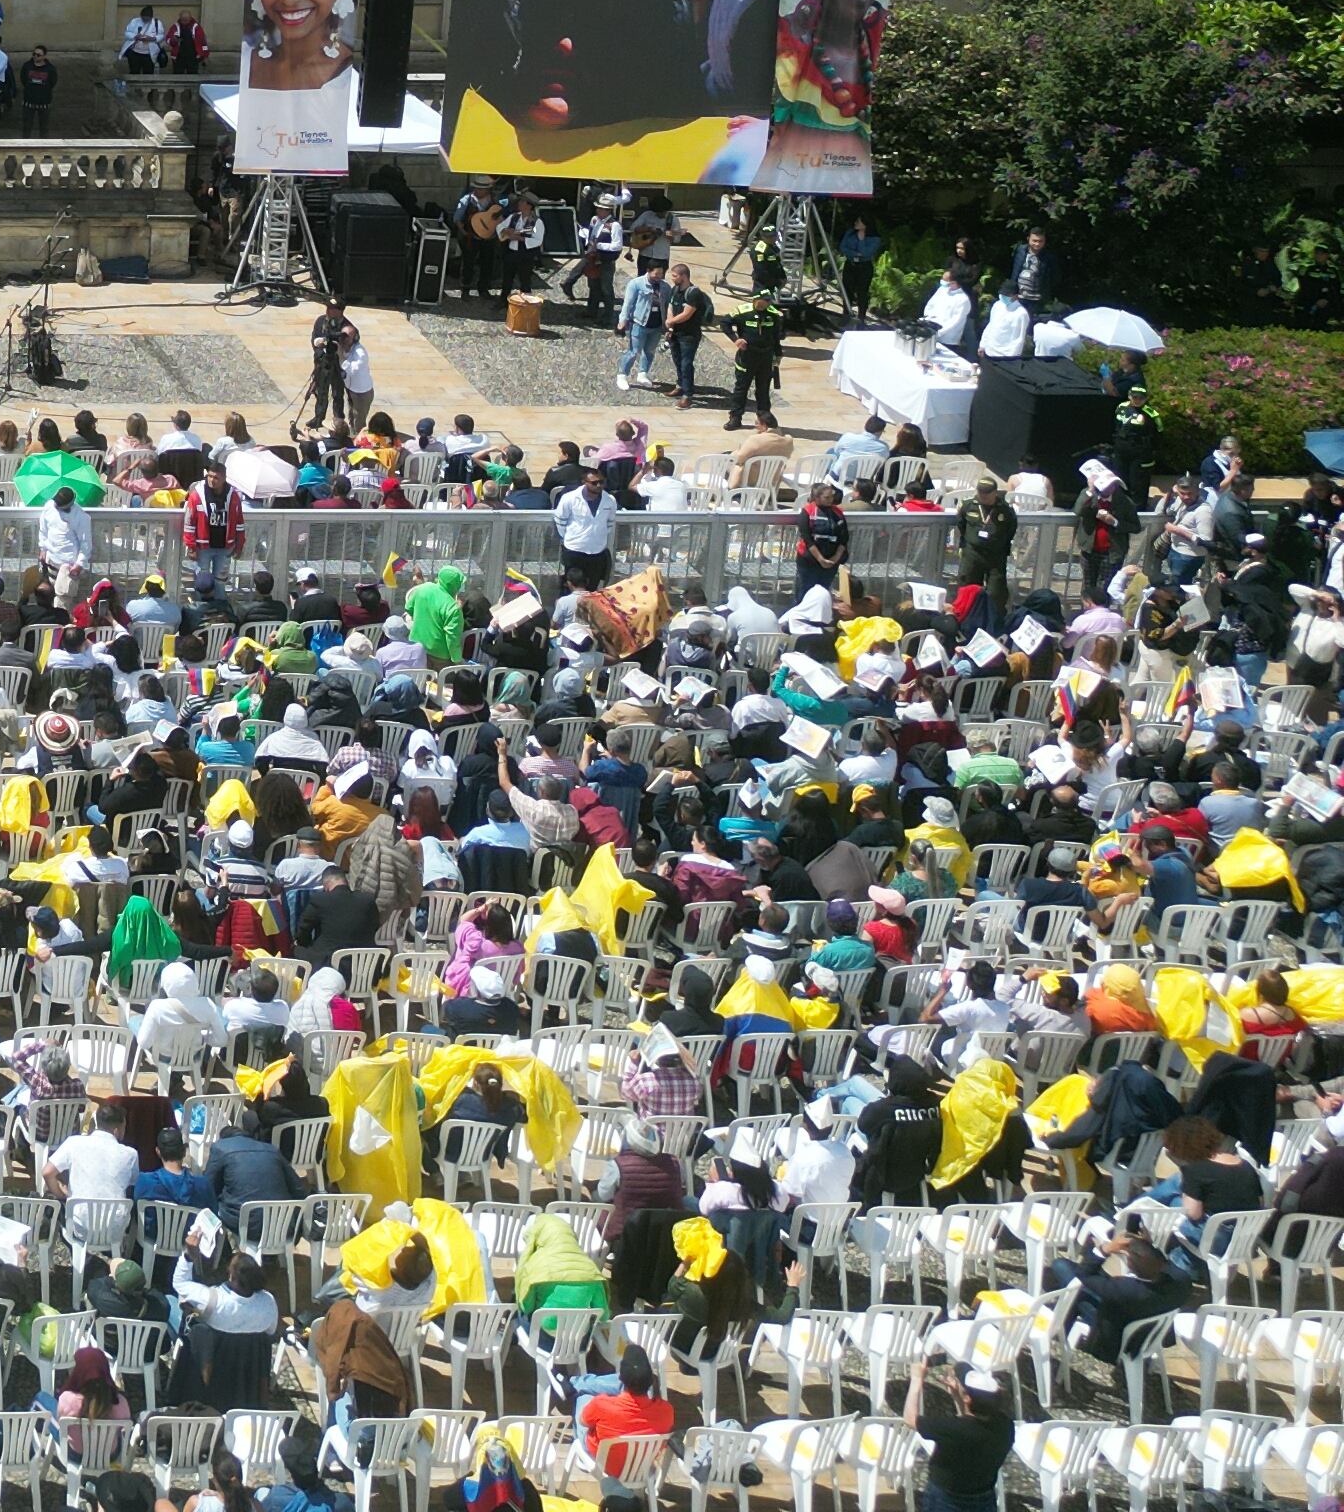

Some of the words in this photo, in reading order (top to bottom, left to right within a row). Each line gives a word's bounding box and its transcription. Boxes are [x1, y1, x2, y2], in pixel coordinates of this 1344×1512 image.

[275, 131, 299, 148] Tú
[299, 131, 328, 139] Tienes
[796, 152, 823, 169] Tú
[824, 153, 857, 162] Tienes
